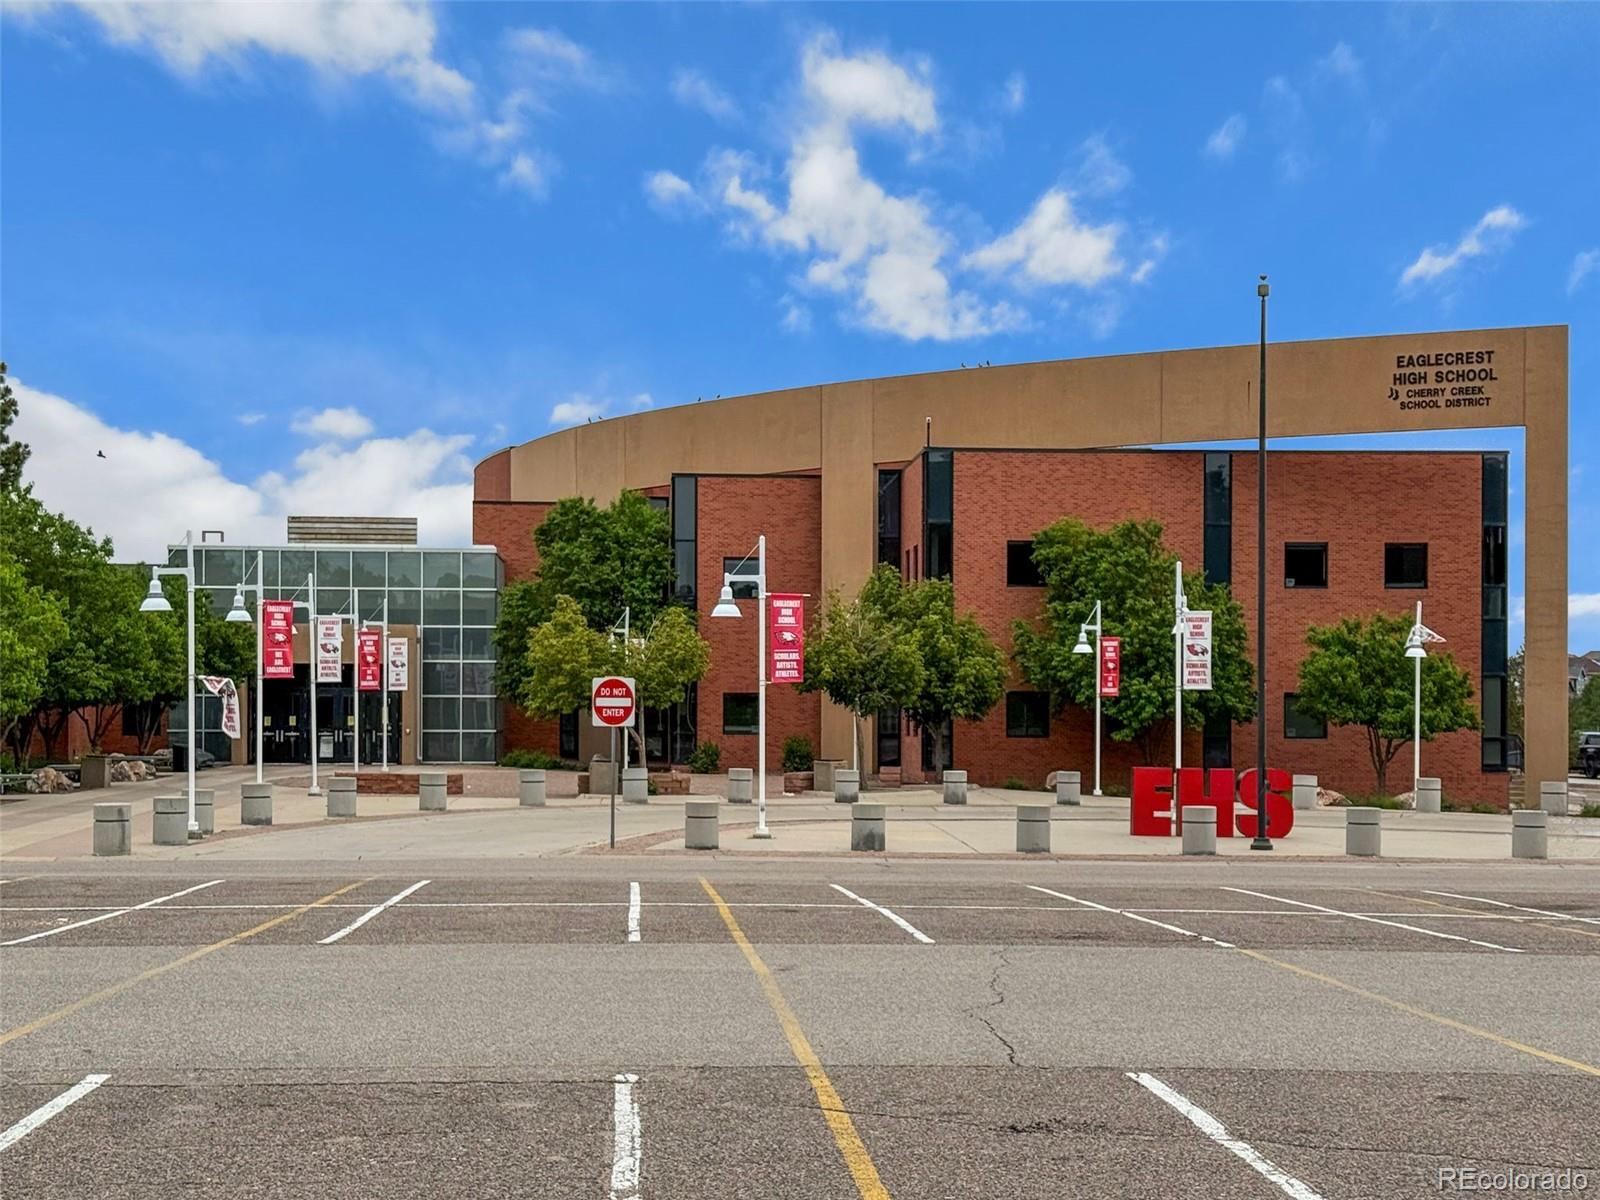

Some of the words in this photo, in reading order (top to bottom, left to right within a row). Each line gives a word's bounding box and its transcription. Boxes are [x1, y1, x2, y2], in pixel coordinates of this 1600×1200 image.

[1396, 350, 1494, 369] EAGLECREST
[1393, 371, 1427, 386] HIGH
[1434, 368, 1498, 383] SCHOOL
[1406, 387, 1446, 399] CHERRY
[1450, 385, 1485, 396] CREEK
[1399, 401, 1442, 410] SCHOOL
[1445, 397, 1492, 408] DISTRICT
[600, 687, 611, 696] DO
[612, 687, 627, 696] NOT
[602, 708, 625, 717] ENTER
[1130, 766, 1294, 839] EHS
